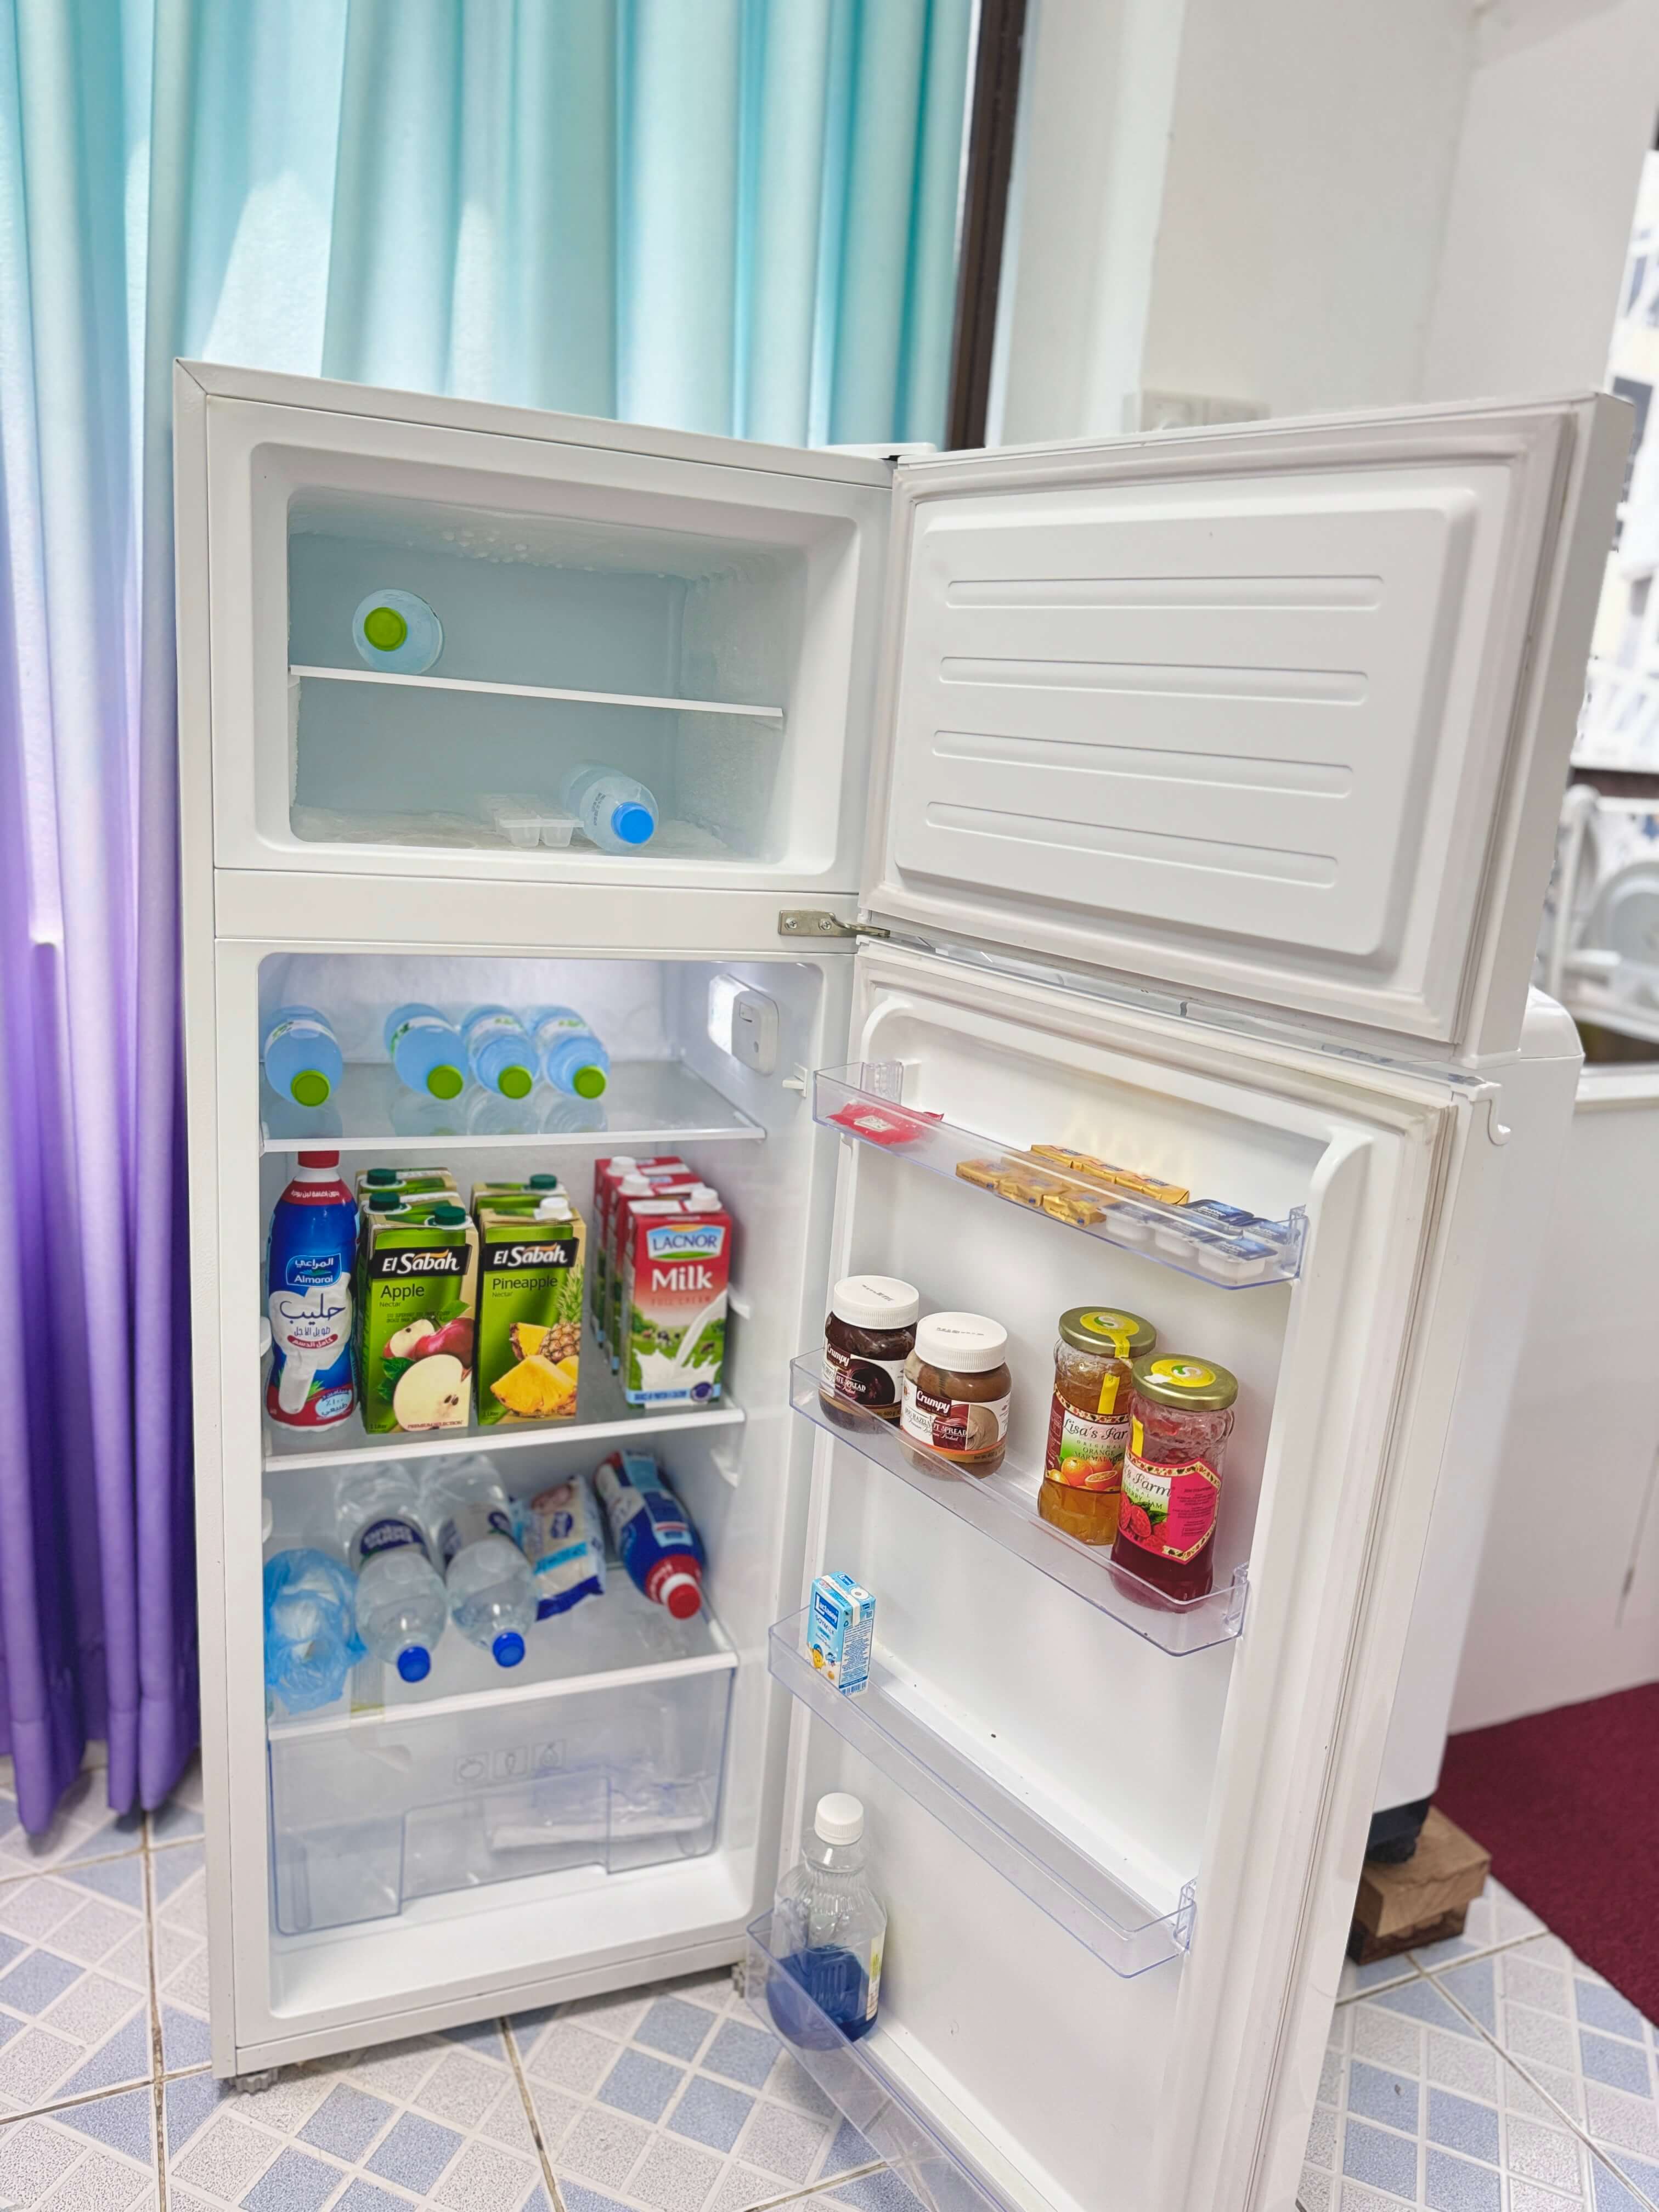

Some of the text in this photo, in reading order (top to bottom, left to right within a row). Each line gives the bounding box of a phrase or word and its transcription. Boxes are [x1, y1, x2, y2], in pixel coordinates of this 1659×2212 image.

[652, 1234, 718, 1251] LACNOR
[295, 1257, 334, 1269] المراعي
[382, 1252, 460, 1274] El Sabah
[493, 1245, 568, 1267] El Sabah
[294, 1275, 334, 1284] Almarai
[493, 1275, 558, 1290] Pineapple
[651, 1265, 713, 1292] Milk
[380, 1284, 425, 1302] Apple
[280, 1293, 346, 1325] حليب
[827, 1343, 850, 1367] Crumpy
[917, 1390, 951, 1413] Crumpy
[1063, 1418, 1128, 1440] Lisa's Far
[1082, 1447, 1115, 1457] ORANGE
